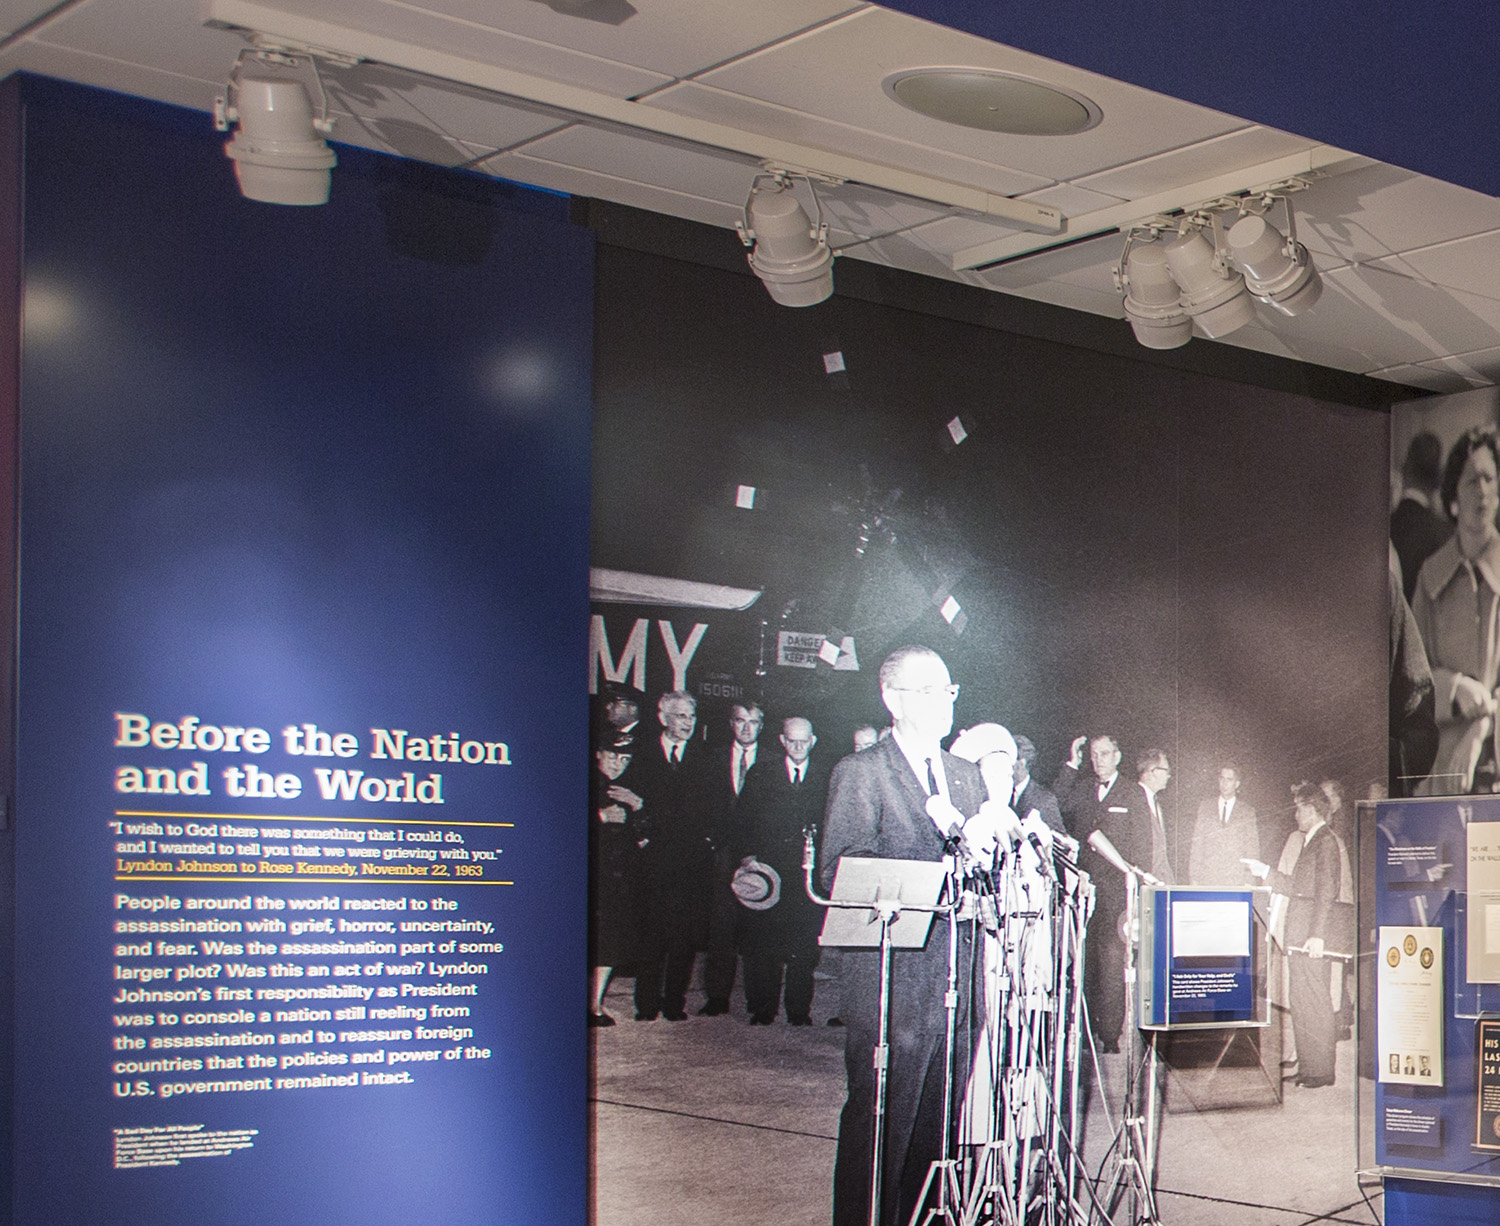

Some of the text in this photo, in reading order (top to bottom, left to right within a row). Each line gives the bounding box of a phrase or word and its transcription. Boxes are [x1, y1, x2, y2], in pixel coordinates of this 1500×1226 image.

[788, 636, 825, 647] DANGE
[589, 615, 709, 694] MY
[785, 653, 804, 663] KEEP
[115, 711, 511, 766] Before the Nation
[114, 762, 444, 804] and the World
[117, 858, 172, 873] Lyndon
[176, 859, 237, 873] Johnson
[240, 861, 256, 873] to
[258, 860, 294, 874] Rose
[360, 862, 428, 876] November
[454, 864, 483, 876] 1963
[116, 893, 457, 912] People around the world reacted to the
[115, 917, 241, 933] assassination
[245, 917, 286, 933] with
[115, 940, 151, 956] and
[201, 940, 243, 956] Was
[245, 939, 277, 956] the
[279, 939, 396, 955] assassination
[399, 940, 435, 956] part
[437, 939, 456, 954] of
[458, 942, 503, 953] some
[115, 960, 487, 982] larger plot? Was this an act of war? Lyndon
[114, 981, 477, 1003] Johnson's first responsibility as President
[114, 1003, 469, 1026] was to console a nation still reeling from
[114, 1024, 472, 1050] the assassination and to reassure foreign
[1485, 1039, 1499, 1048] HIS
[114, 1045, 491, 1074] countries that the policies and power of the
[159, 1076, 272, 1097] government
[274, 1071, 358, 1090] remained
